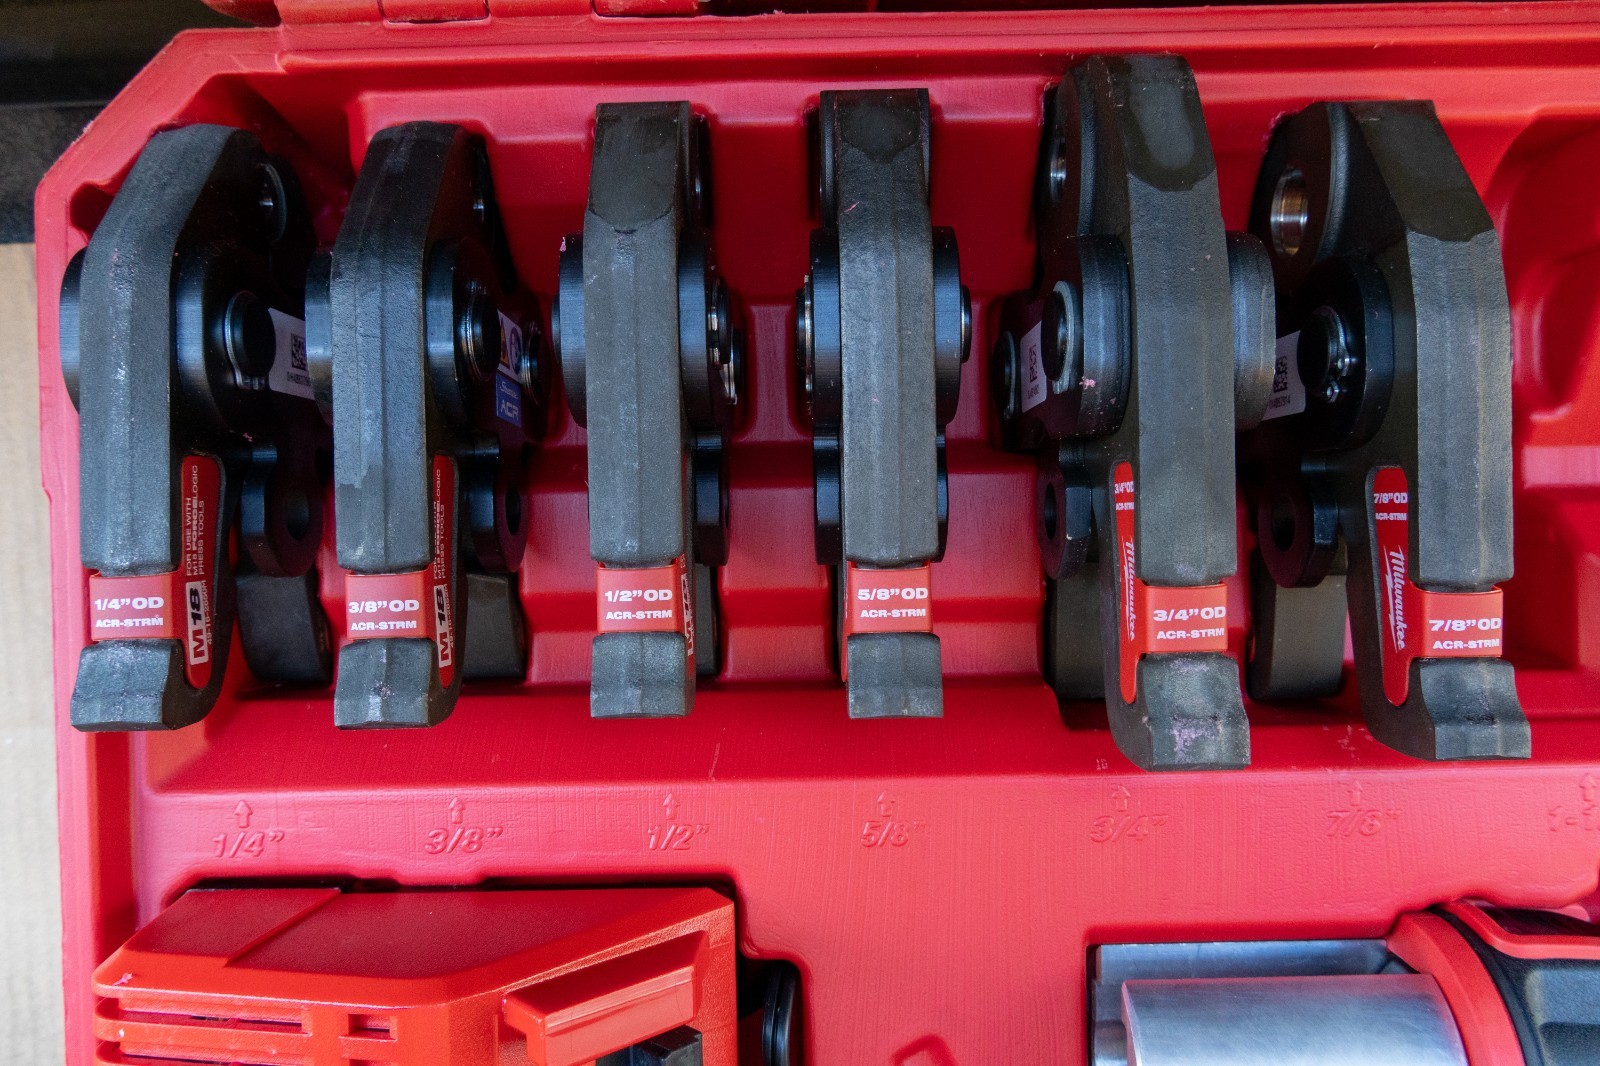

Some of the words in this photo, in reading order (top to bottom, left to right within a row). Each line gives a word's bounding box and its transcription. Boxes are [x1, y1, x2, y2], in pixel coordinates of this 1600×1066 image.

[191, 465, 199, 551] FORCELOGIC
[1389, 546, 1406, 650] Milwaukee
[605, 610, 673, 620] ACR-STRM
[860, 609, 926, 618] ACR-STRM
[95, 618, 163, 628] ACR-STRM
[351, 620, 417, 631] ACR-STRM
[1156, 627, 1225, 640] ACR-STRM
[1432, 638, 1500, 650] ACR-STRM
